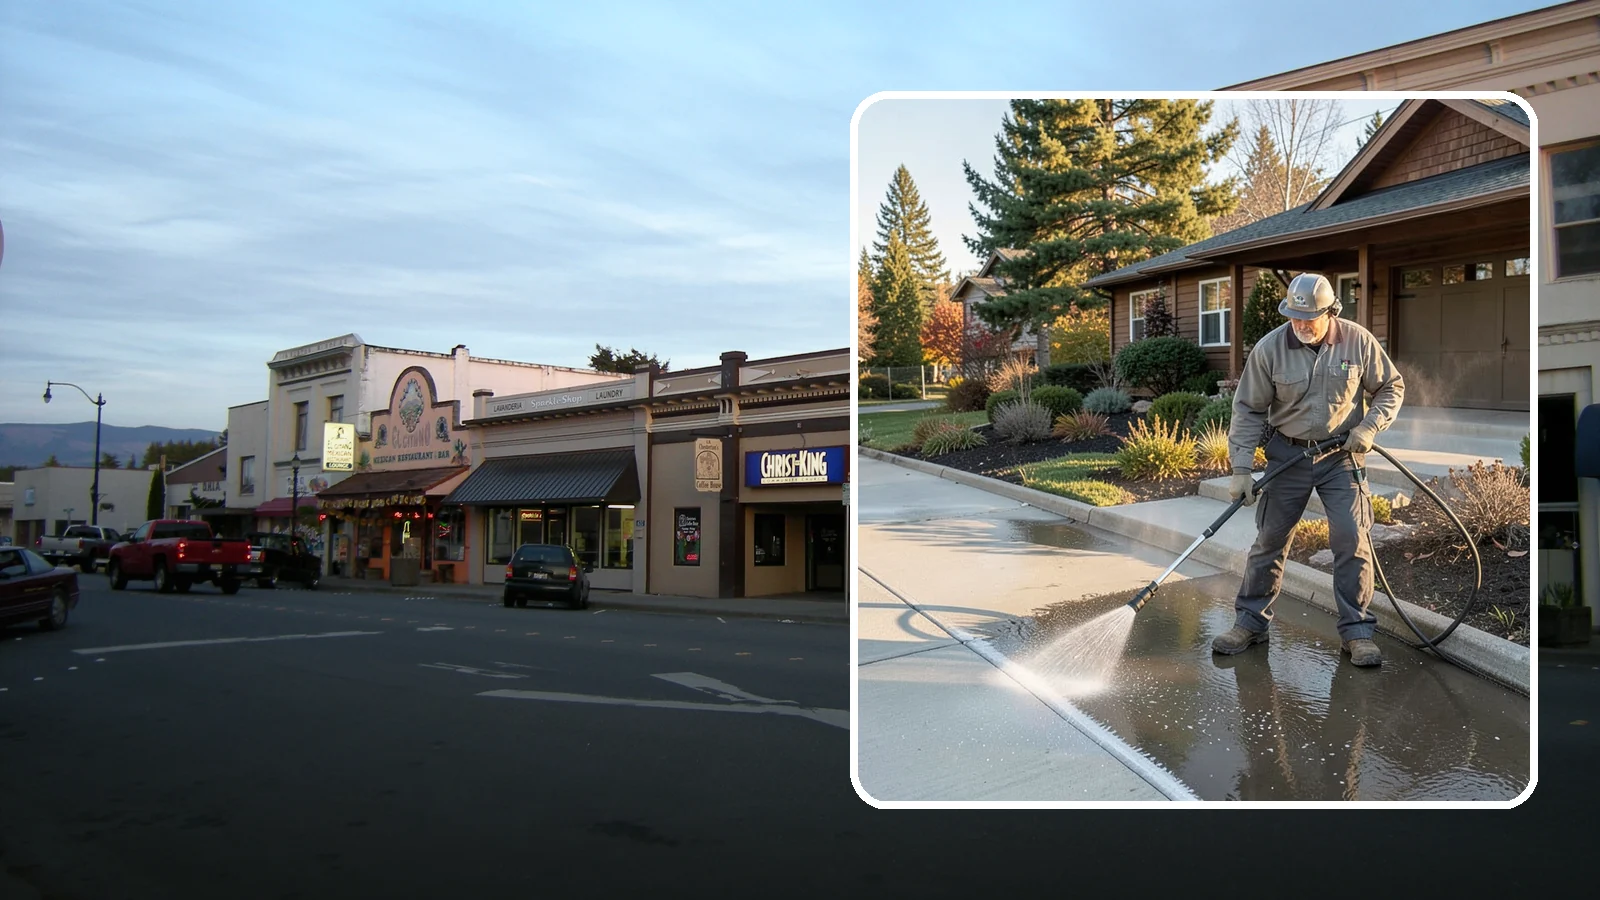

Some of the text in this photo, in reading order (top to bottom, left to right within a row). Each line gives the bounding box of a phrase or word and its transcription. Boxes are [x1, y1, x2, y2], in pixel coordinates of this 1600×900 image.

[493, 389, 624, 412] LAVANDERIA Sparkle Shop LAUNDRY
[373, 455, 396, 464] MEXICAN
[397, 451, 433, 462] RESTAURANT
[438, 450, 450, 459] BAR
[697, 481, 721, 489] Coffee House
